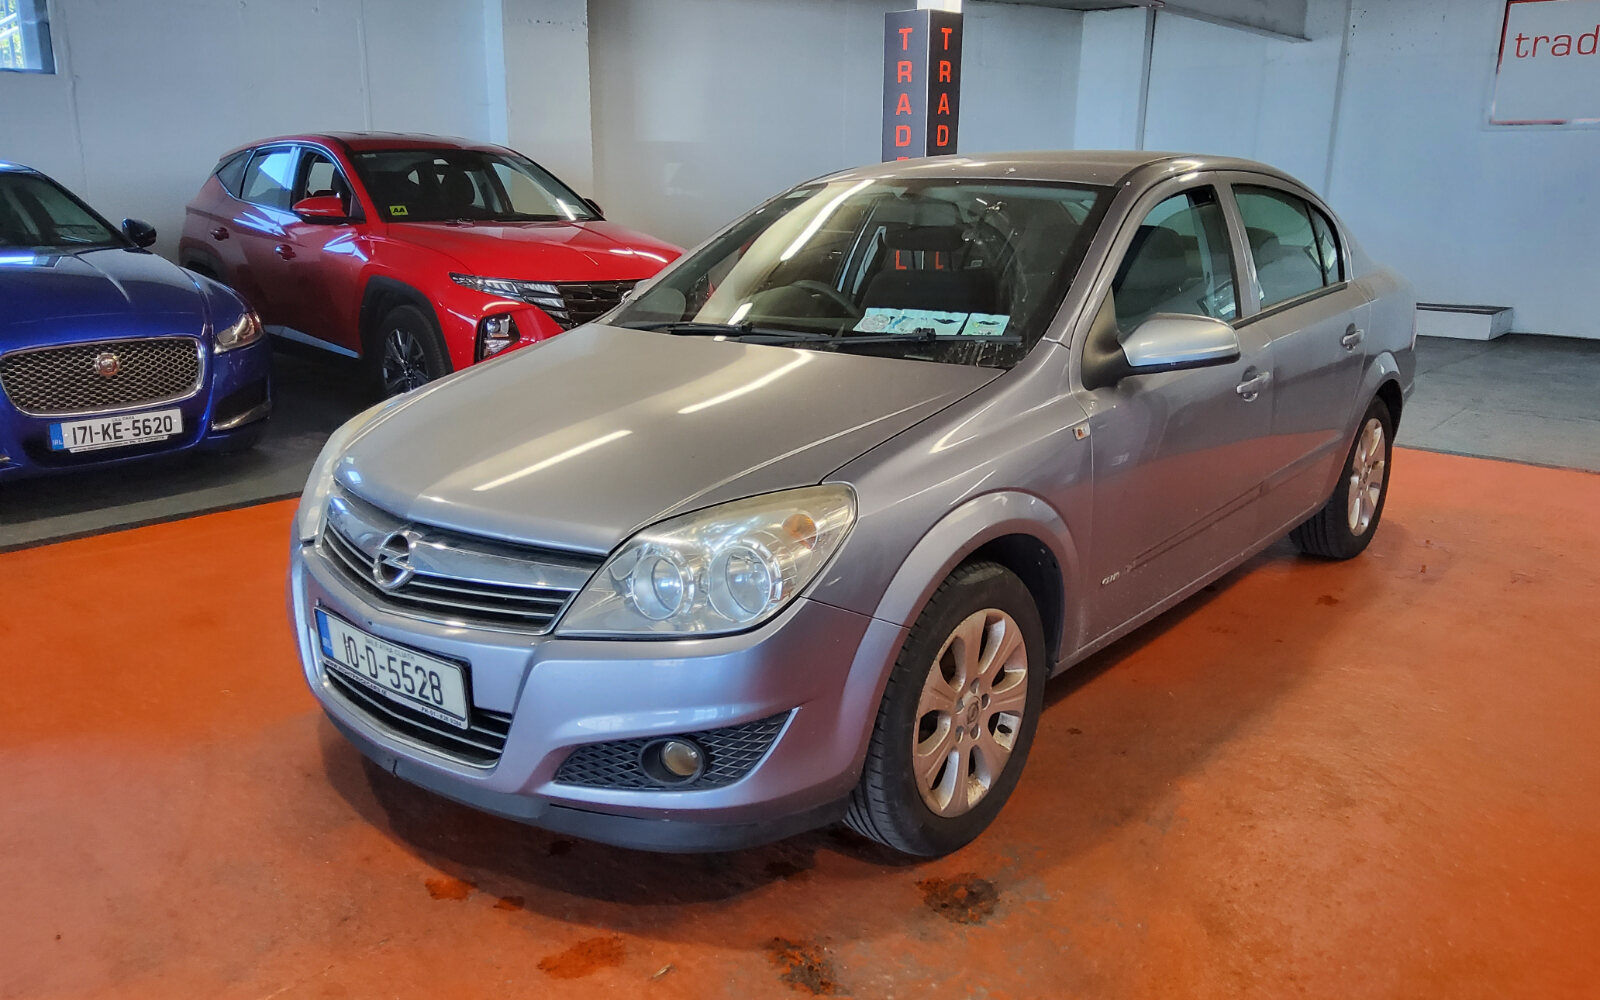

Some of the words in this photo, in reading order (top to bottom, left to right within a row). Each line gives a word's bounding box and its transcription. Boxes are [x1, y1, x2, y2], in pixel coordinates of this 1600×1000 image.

[1515, 24, 1600, 58] trad
[895, 27, 913, 160] TRAD
[72, 415, 173, 446] 171-KE-5620
[342, 632, 444, 706] 10-D-5528
